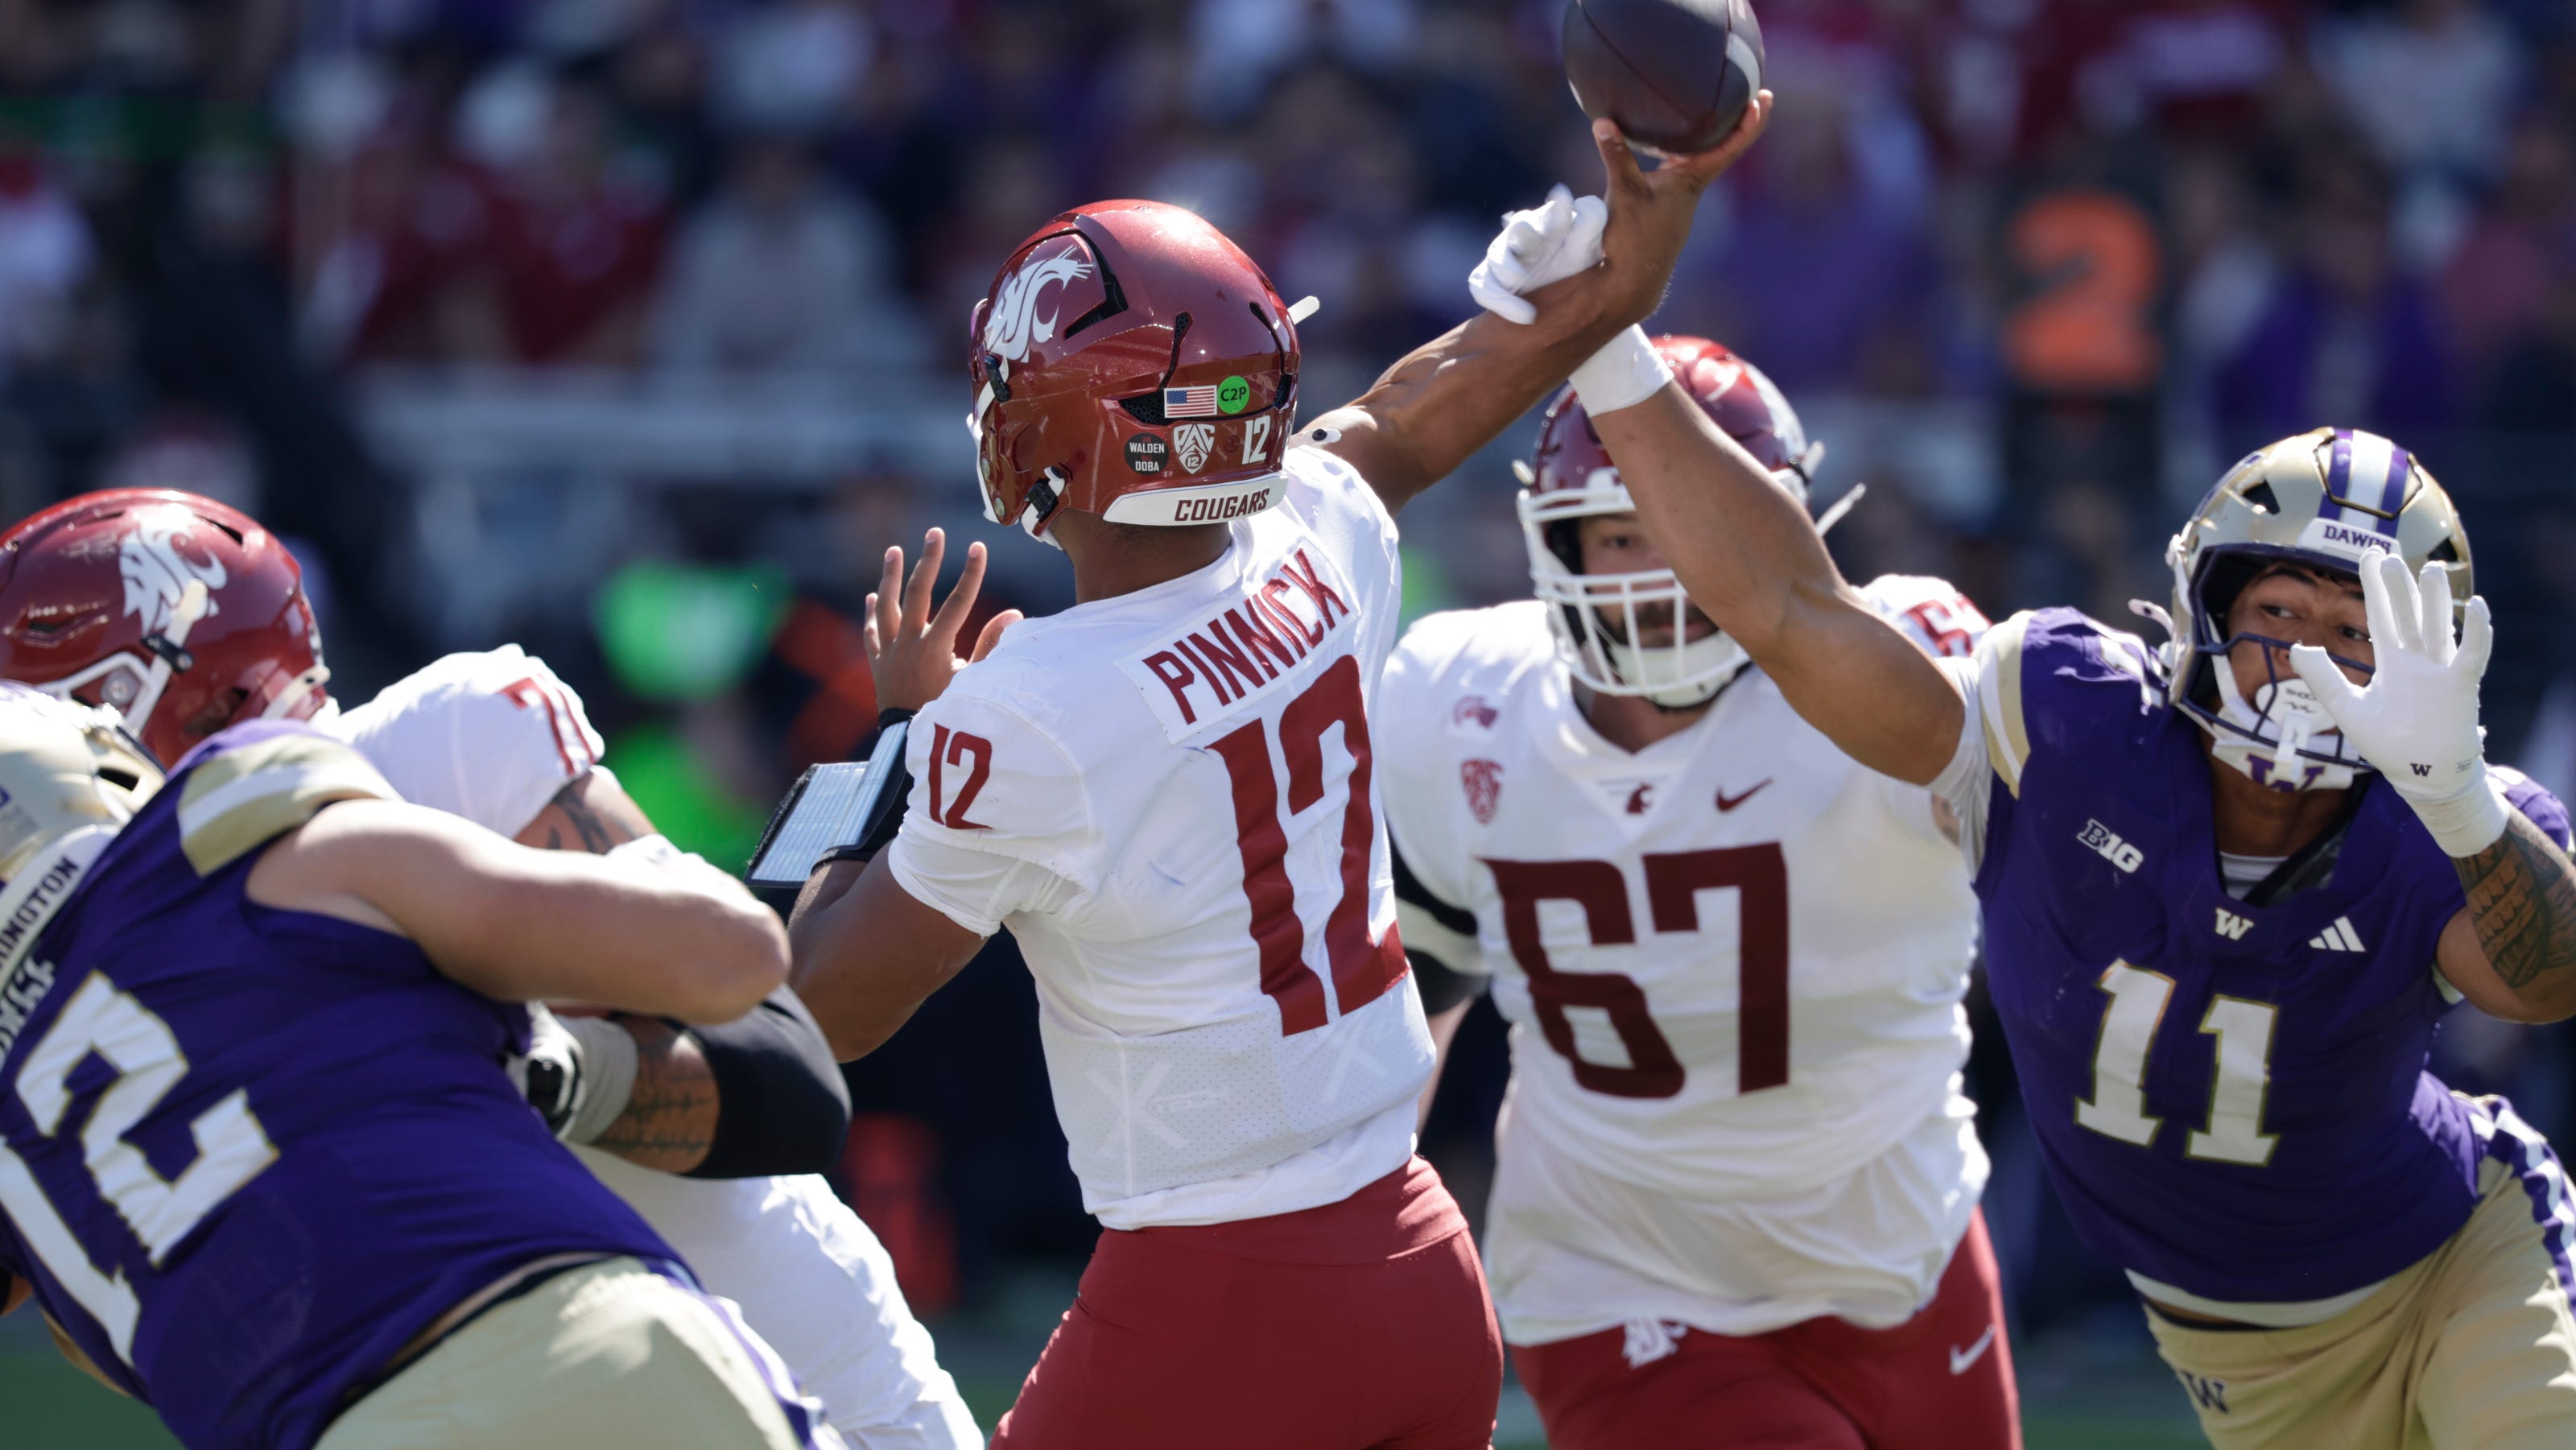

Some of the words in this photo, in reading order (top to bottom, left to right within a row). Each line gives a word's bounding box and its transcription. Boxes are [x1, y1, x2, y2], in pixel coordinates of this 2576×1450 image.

[1220, 386, 1247, 403] C2P
[1129, 442, 1165, 453] WALDEN
[1173, 423, 1215, 454] PAC
[1241, 415, 1271, 465] 12
[1135, 461, 1159, 472] DOBA
[1187, 456, 1200, 467] 12
[1174, 488, 1269, 522] COUGARS
[1142, 547, 1349, 725] PINNICK
[928, 721, 993, 830] 12
[2410, 762, 2432, 778] W
[1204, 654, 1410, 1037] 12
[2215, 907, 2255, 940] W
[1474, 841, 1789, 1099] 67
[2074, 957, 2279, 1166] 11
[2180, 1369, 2228, 1415] W
